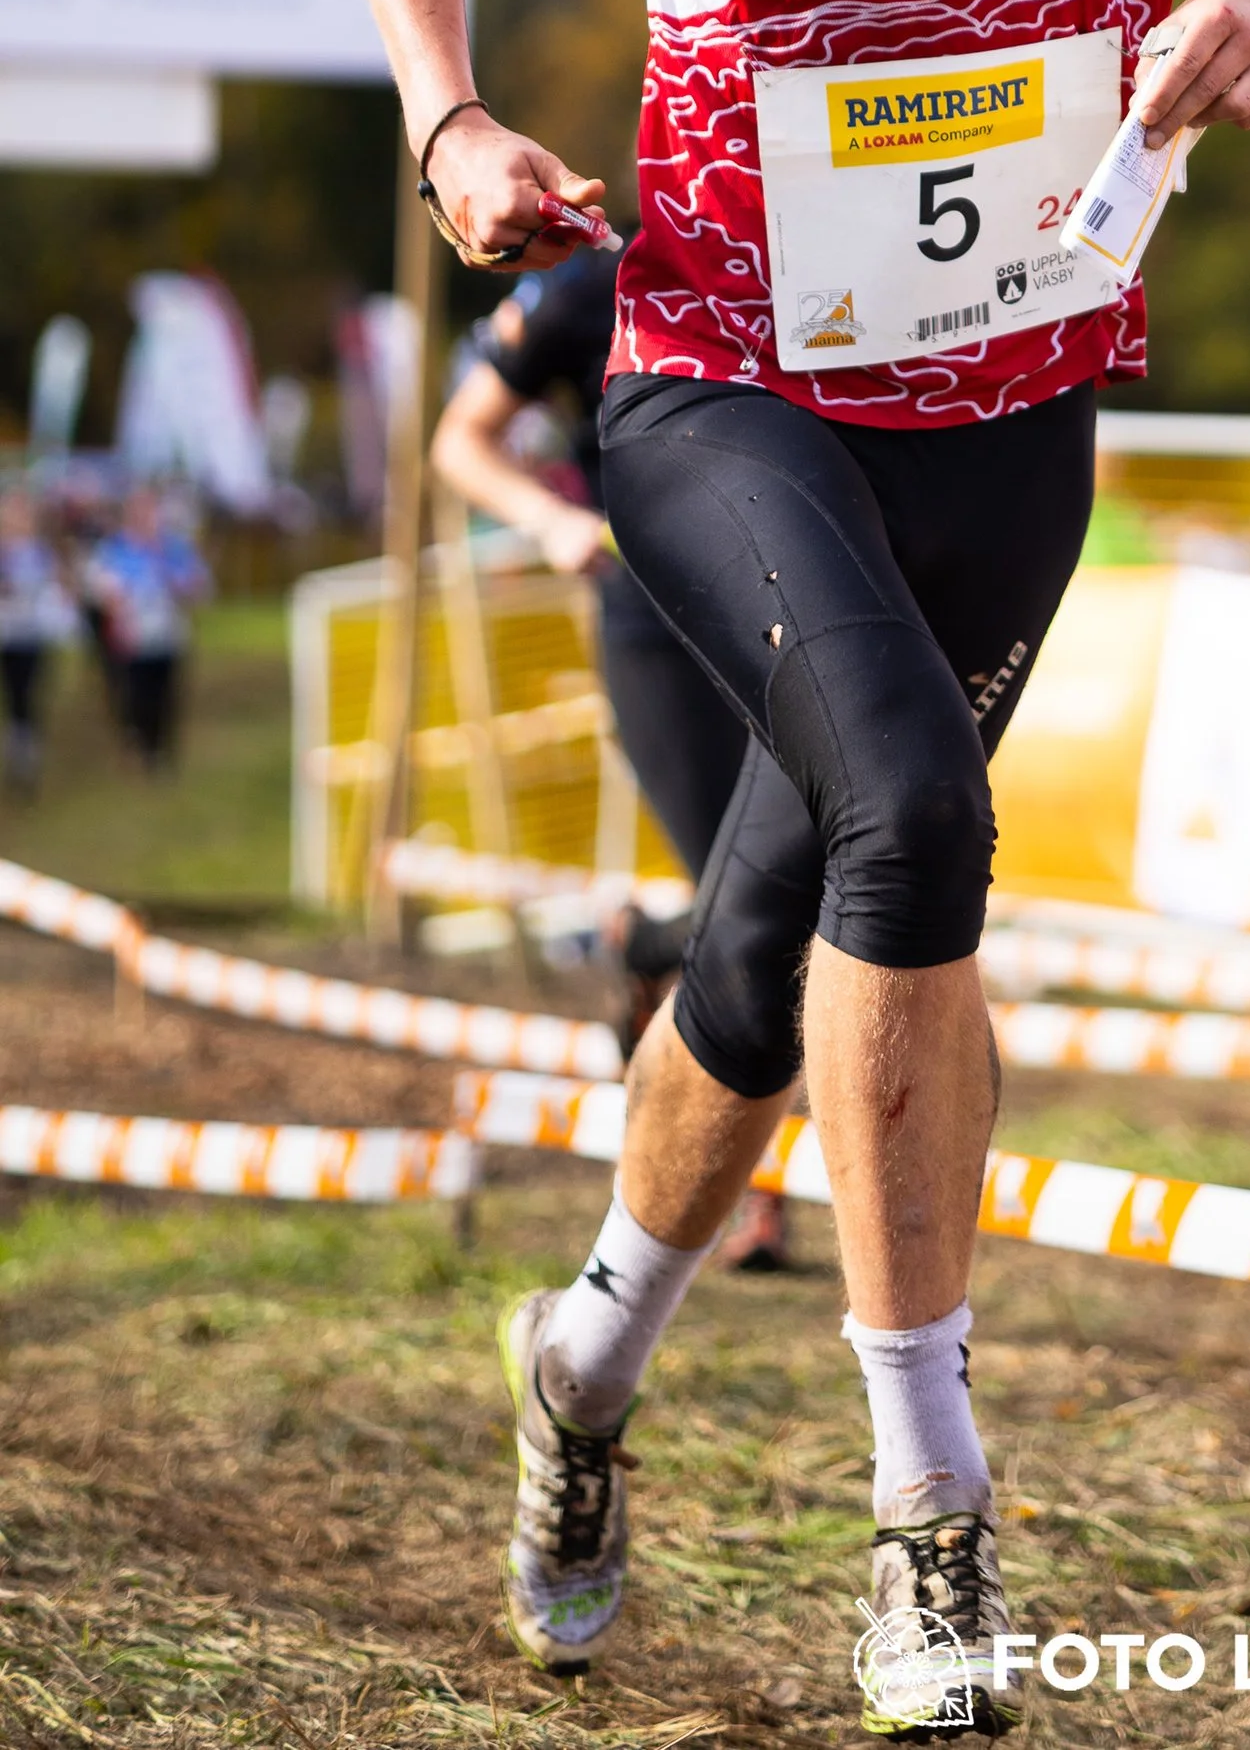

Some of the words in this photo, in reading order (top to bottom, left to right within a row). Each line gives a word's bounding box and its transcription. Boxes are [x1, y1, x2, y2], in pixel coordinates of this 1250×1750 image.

[845, 77, 1028, 127] RAMIRENT
[849, 137, 860, 150] A
[864, 132, 924, 149] LOXAM
[928, 124, 994, 143] Company
[917, 163, 981, 262] 5
[1031, 246, 1078, 272] UPPLA
[1033, 266, 1075, 290] VÄSBY
[804, 334, 854, 348] manna
